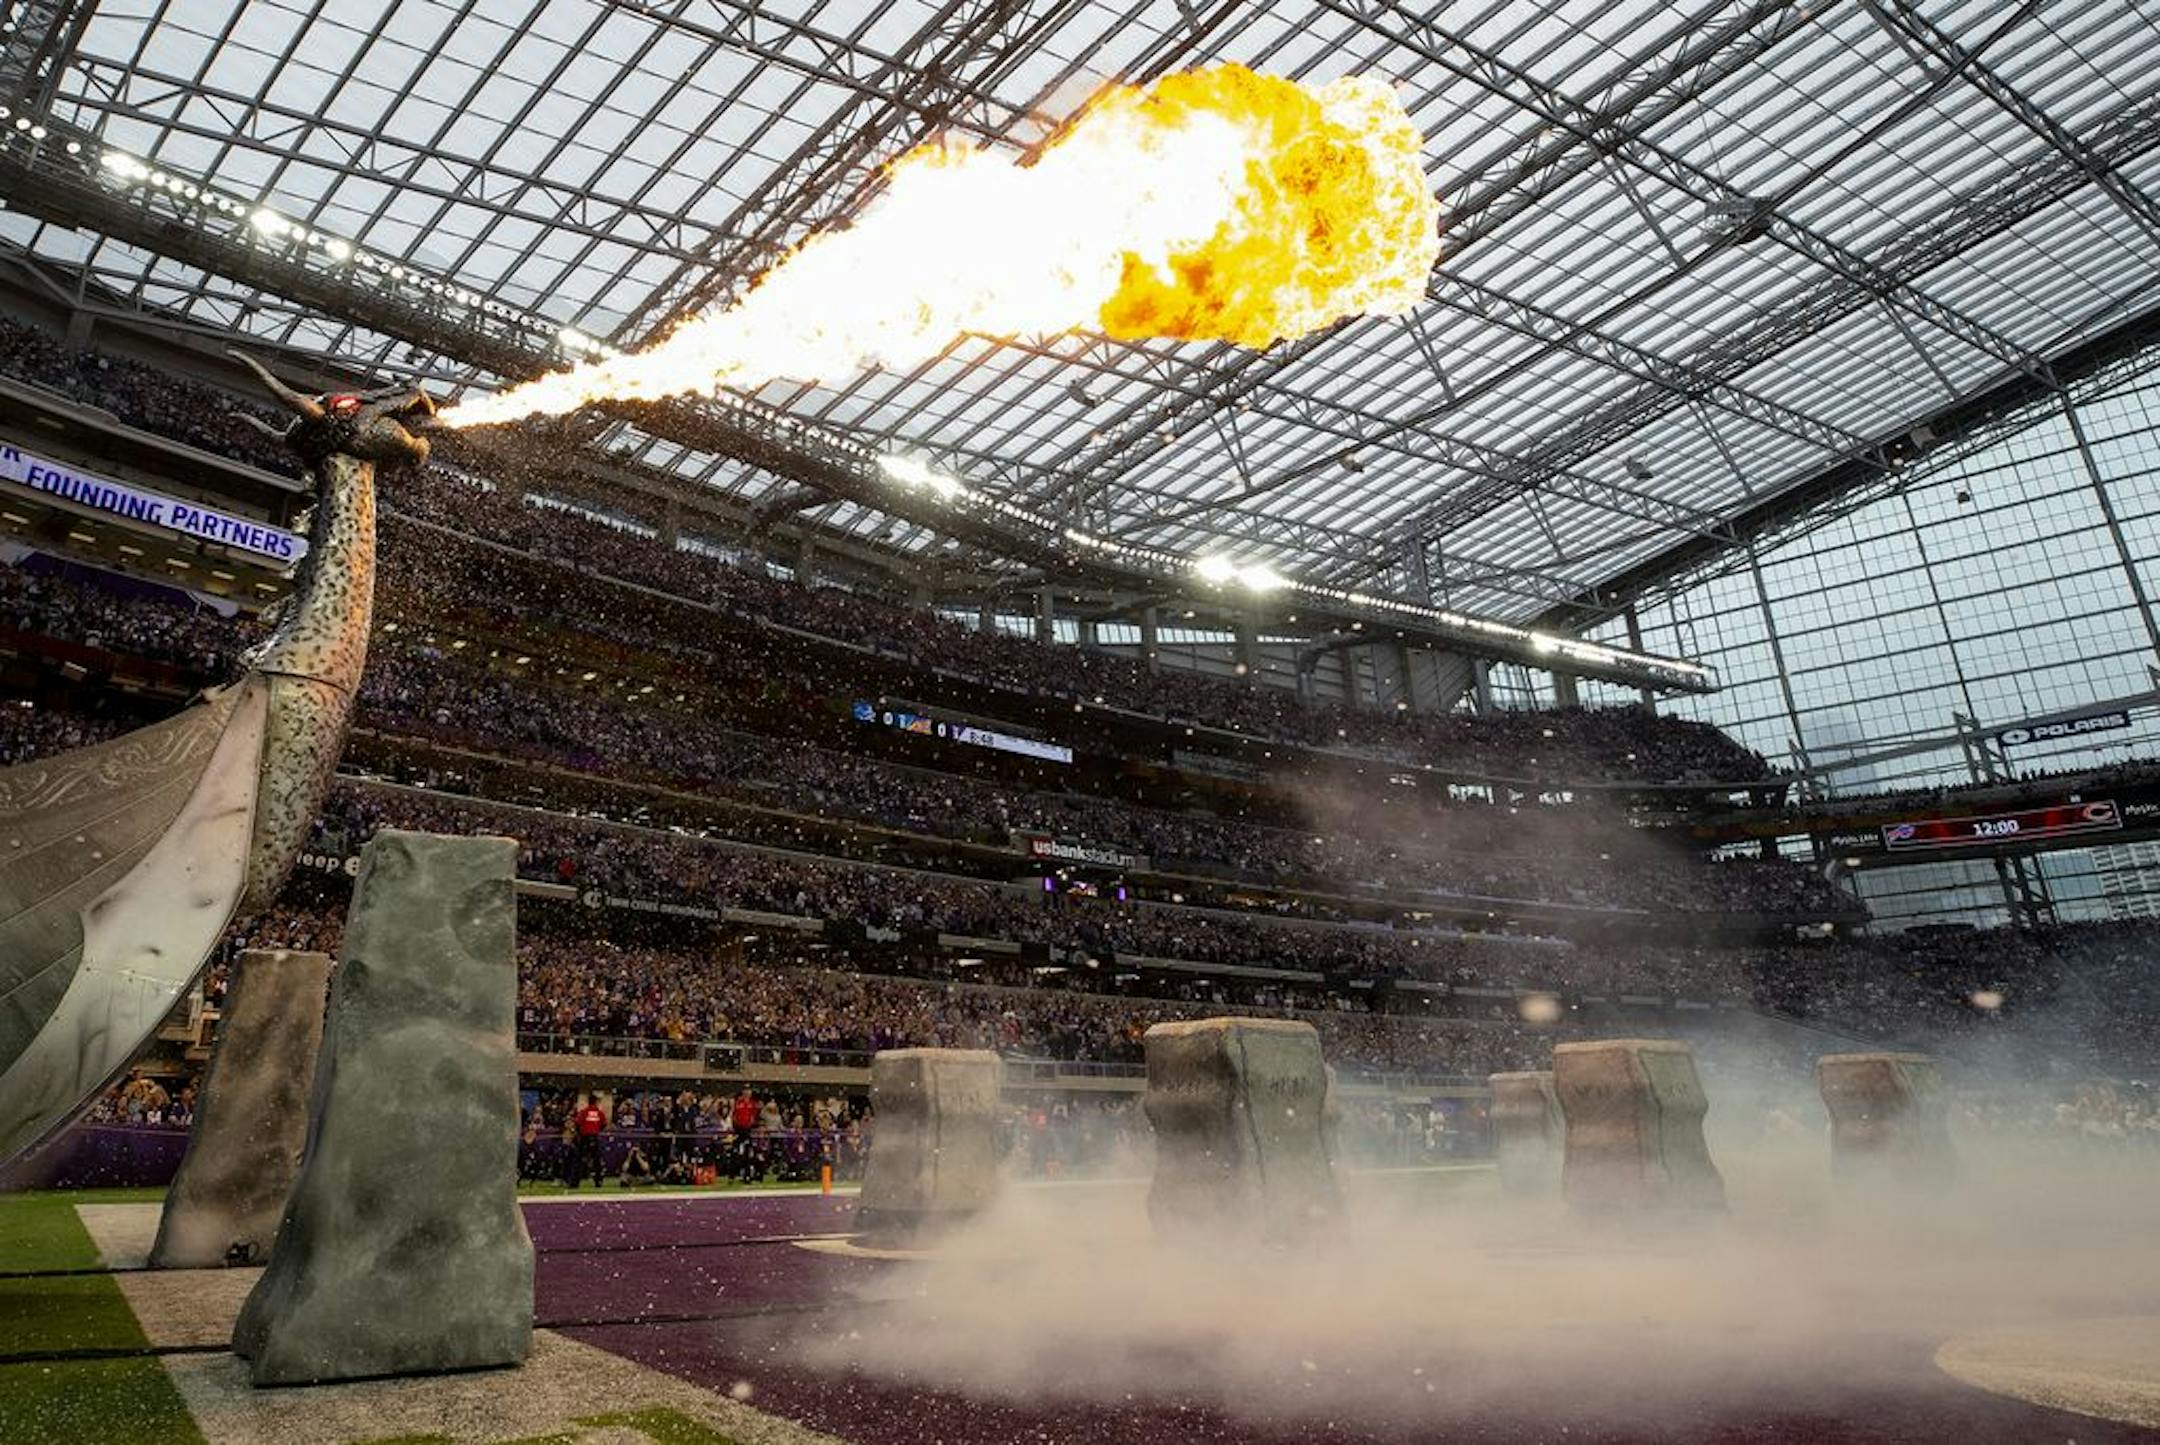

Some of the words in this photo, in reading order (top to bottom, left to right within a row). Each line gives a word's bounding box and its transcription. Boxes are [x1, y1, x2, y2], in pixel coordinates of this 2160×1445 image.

[171, 506, 293, 557] PARTNERS
[2033, 713, 2125, 739] POLARIS
[1974, 819, 2020, 837] 12:00
